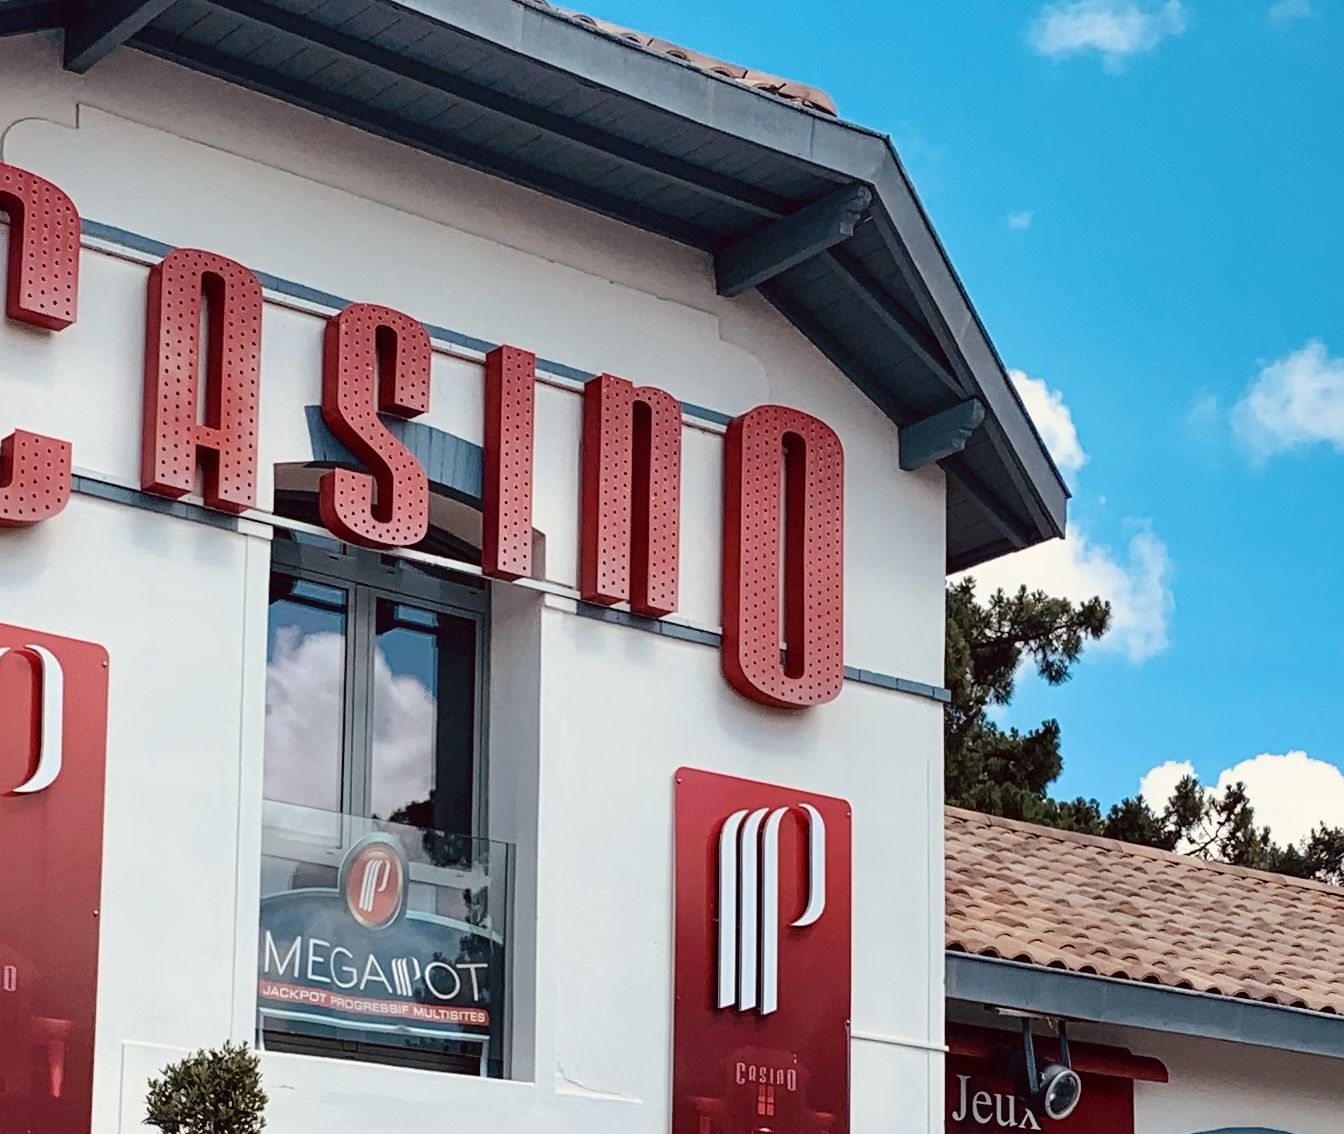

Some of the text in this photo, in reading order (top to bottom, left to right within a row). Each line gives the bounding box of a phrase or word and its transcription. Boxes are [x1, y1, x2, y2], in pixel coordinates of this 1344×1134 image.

[263, 930, 489, 1002] MEGAPOT
[262, 985, 485, 1023] JACKPOT PROGRESSIF MULTISITES
